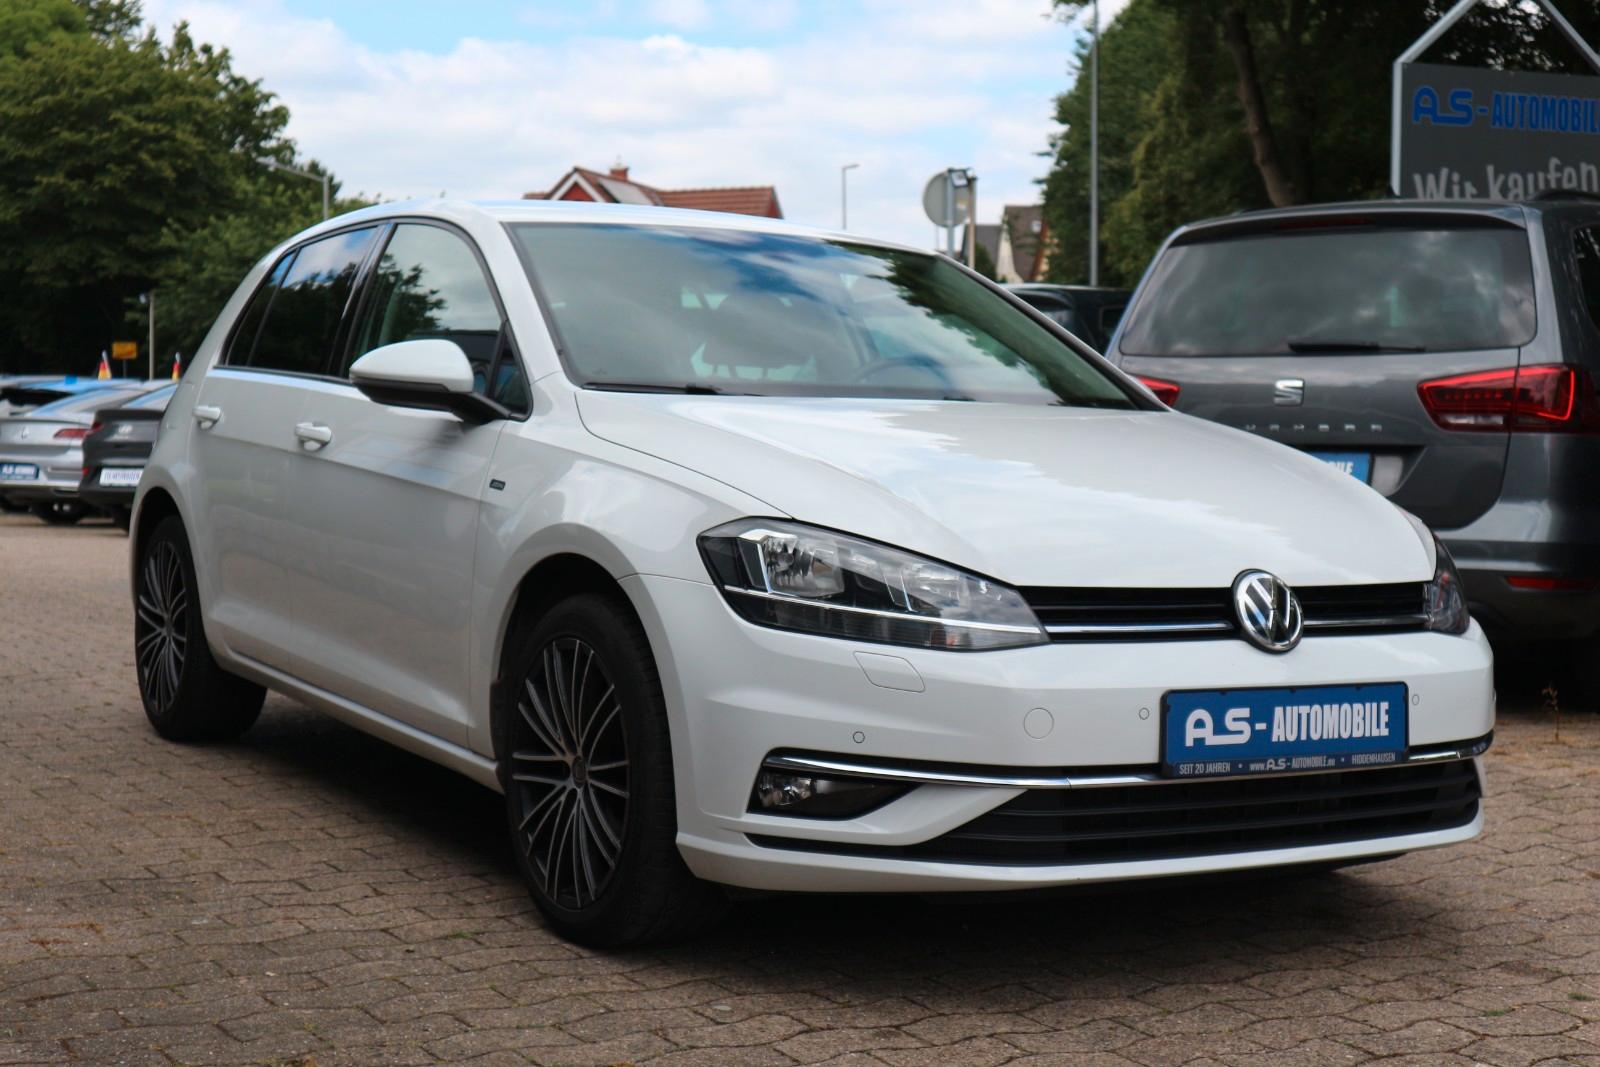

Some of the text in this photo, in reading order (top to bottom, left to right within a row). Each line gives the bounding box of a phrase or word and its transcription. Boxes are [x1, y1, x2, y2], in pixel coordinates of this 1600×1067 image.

[1412, 85, 1600, 134] AS-AUTOMOBIL
[1413, 167, 1478, 199] Wir
[1179, 763, 1194, 775] SEIT
[1194, 762, 1205, 774] 20
[1205, 760, 1231, 774] JAHREN
